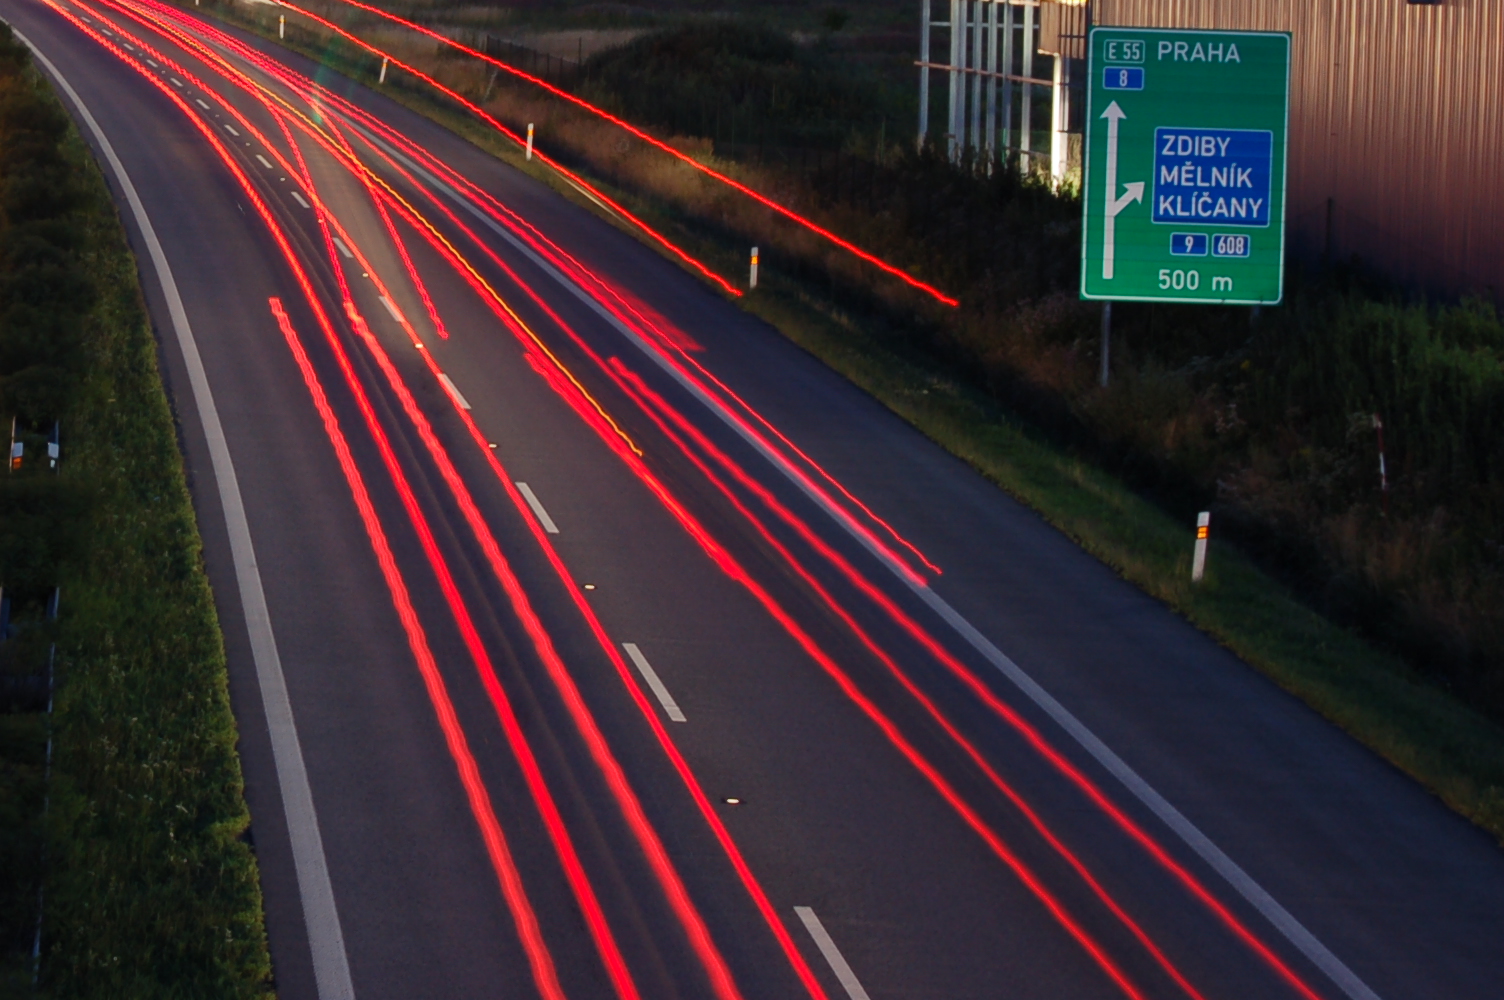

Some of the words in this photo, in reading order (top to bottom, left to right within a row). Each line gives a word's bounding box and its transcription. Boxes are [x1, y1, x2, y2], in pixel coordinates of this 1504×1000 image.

[1108, 42, 1117, 60] E
[1122, 42, 1141, 61] 55
[1157, 41, 1241, 63] PRAHA
[1119, 69, 1128, 87] 8
[1161, 135, 1231, 157] ZDIBY
[1160, 161, 1253, 188] MĚLNÍK
[1159, 191, 1263, 218] KLÍČANY
[1184, 235, 1194, 253] 9
[1217, 235, 1245, 254] 608
[1158, 268, 1200, 291] 500
[1211, 276, 1233, 292] m
